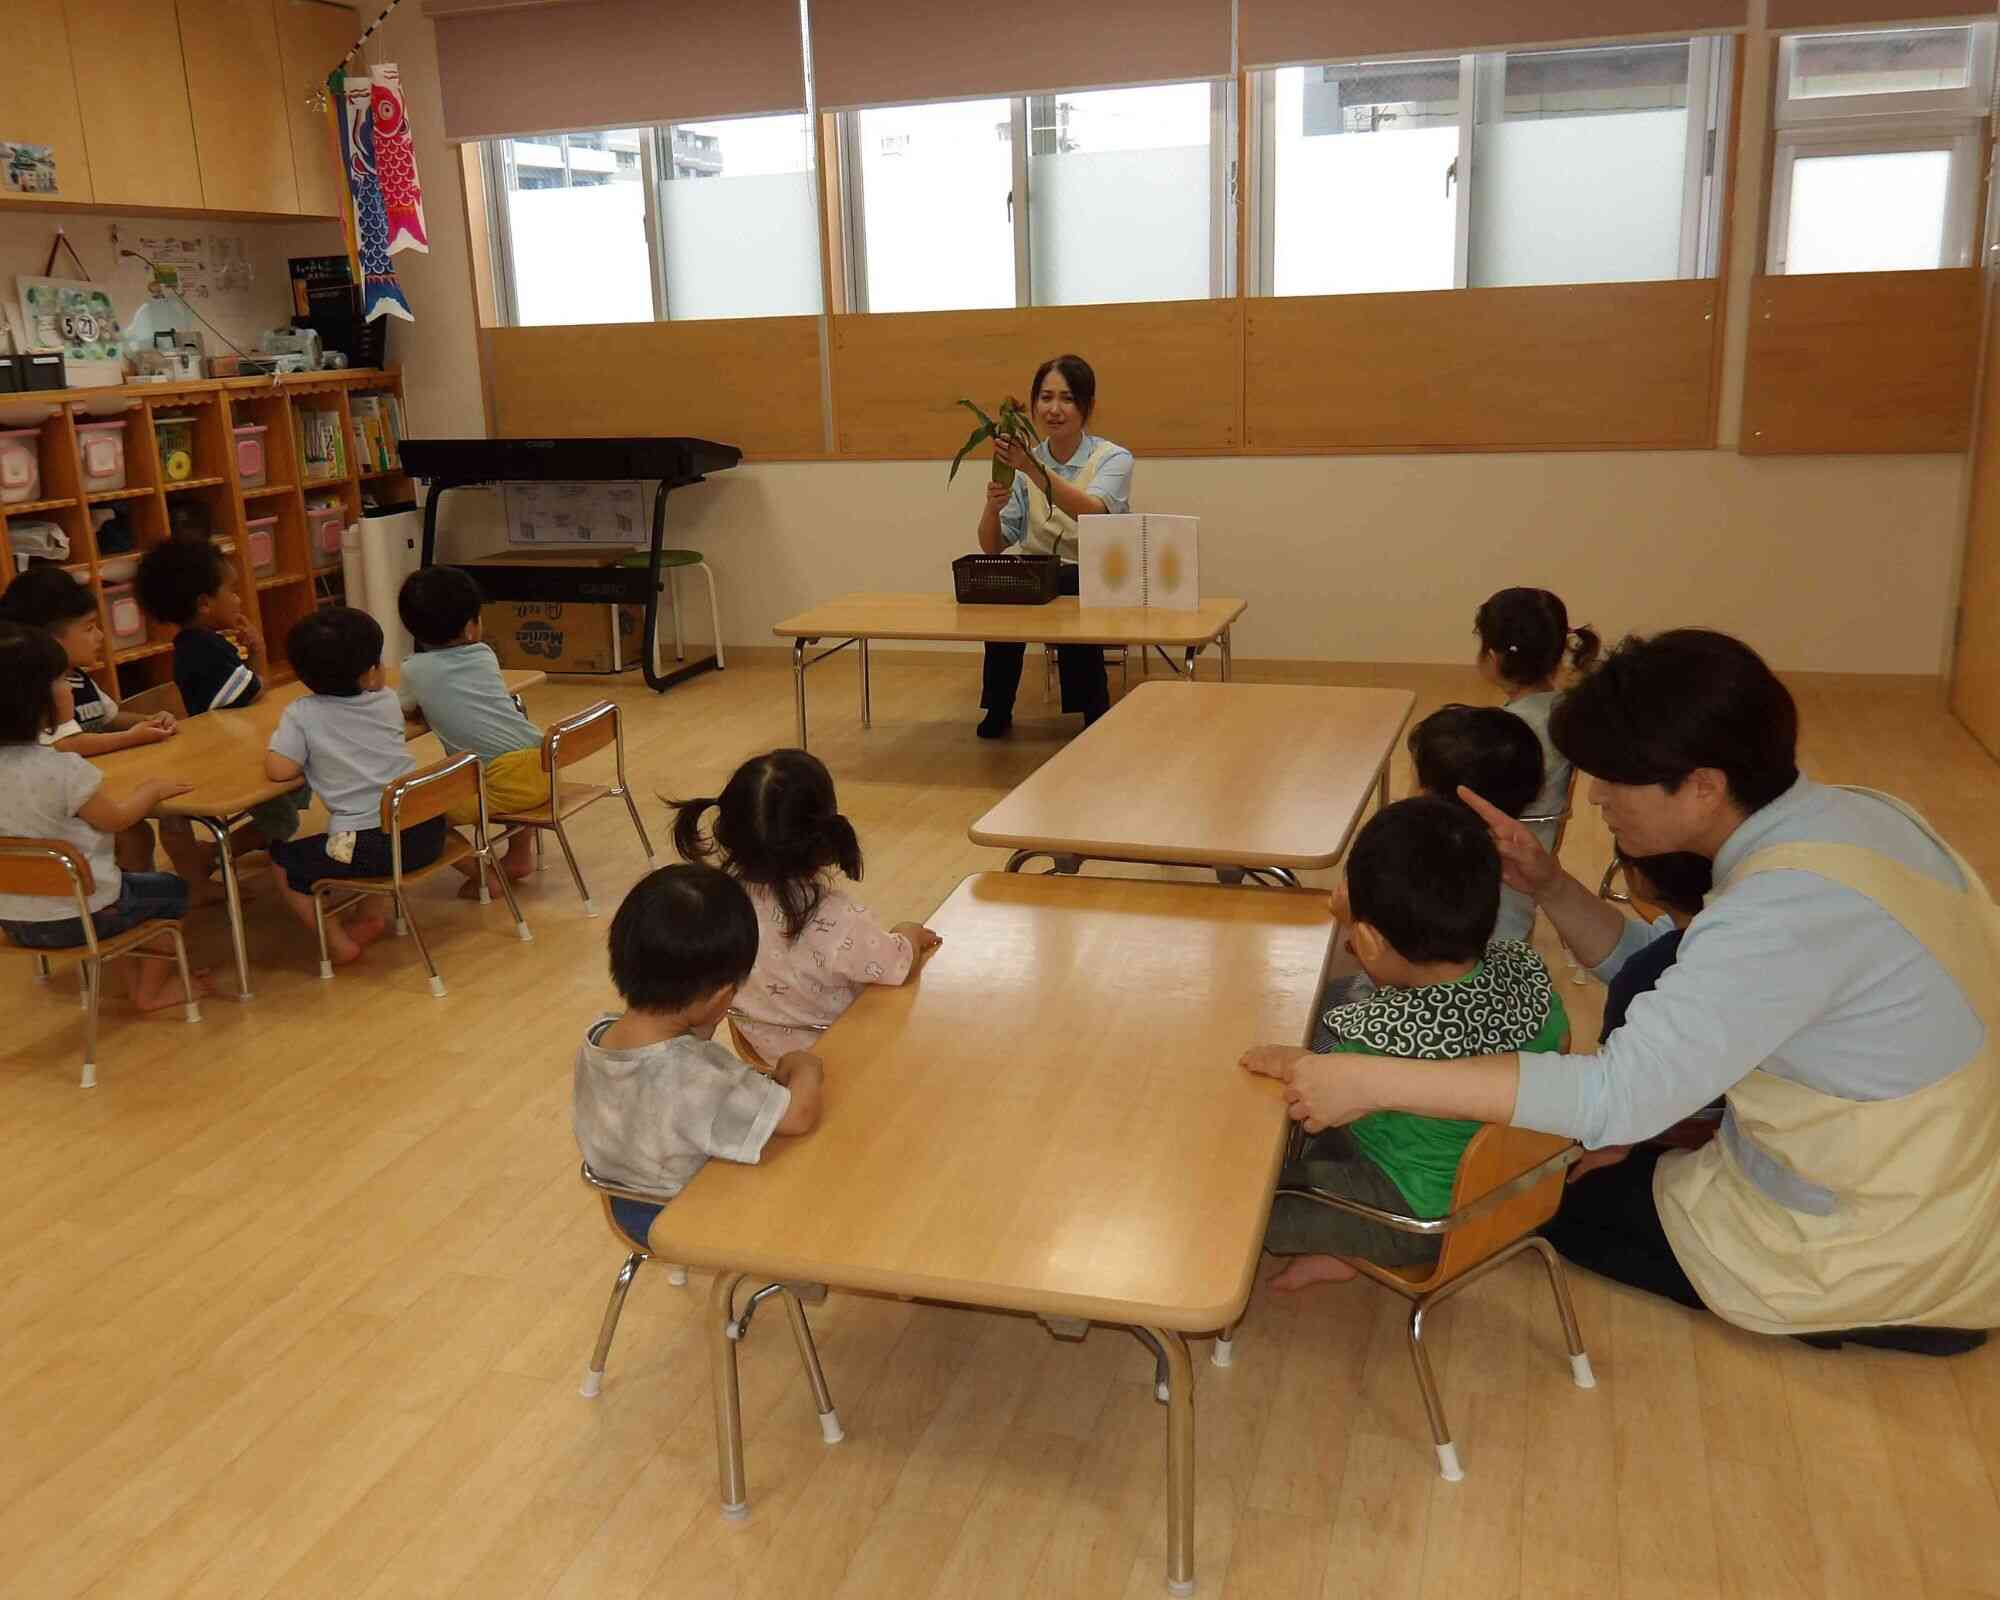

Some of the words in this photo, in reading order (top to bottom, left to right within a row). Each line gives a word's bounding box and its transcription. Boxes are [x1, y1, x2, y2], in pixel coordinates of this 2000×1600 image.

[64, 318, 73, 335] 5
[79, 318, 93, 335] 21
[515, 631, 563, 646] Merries
